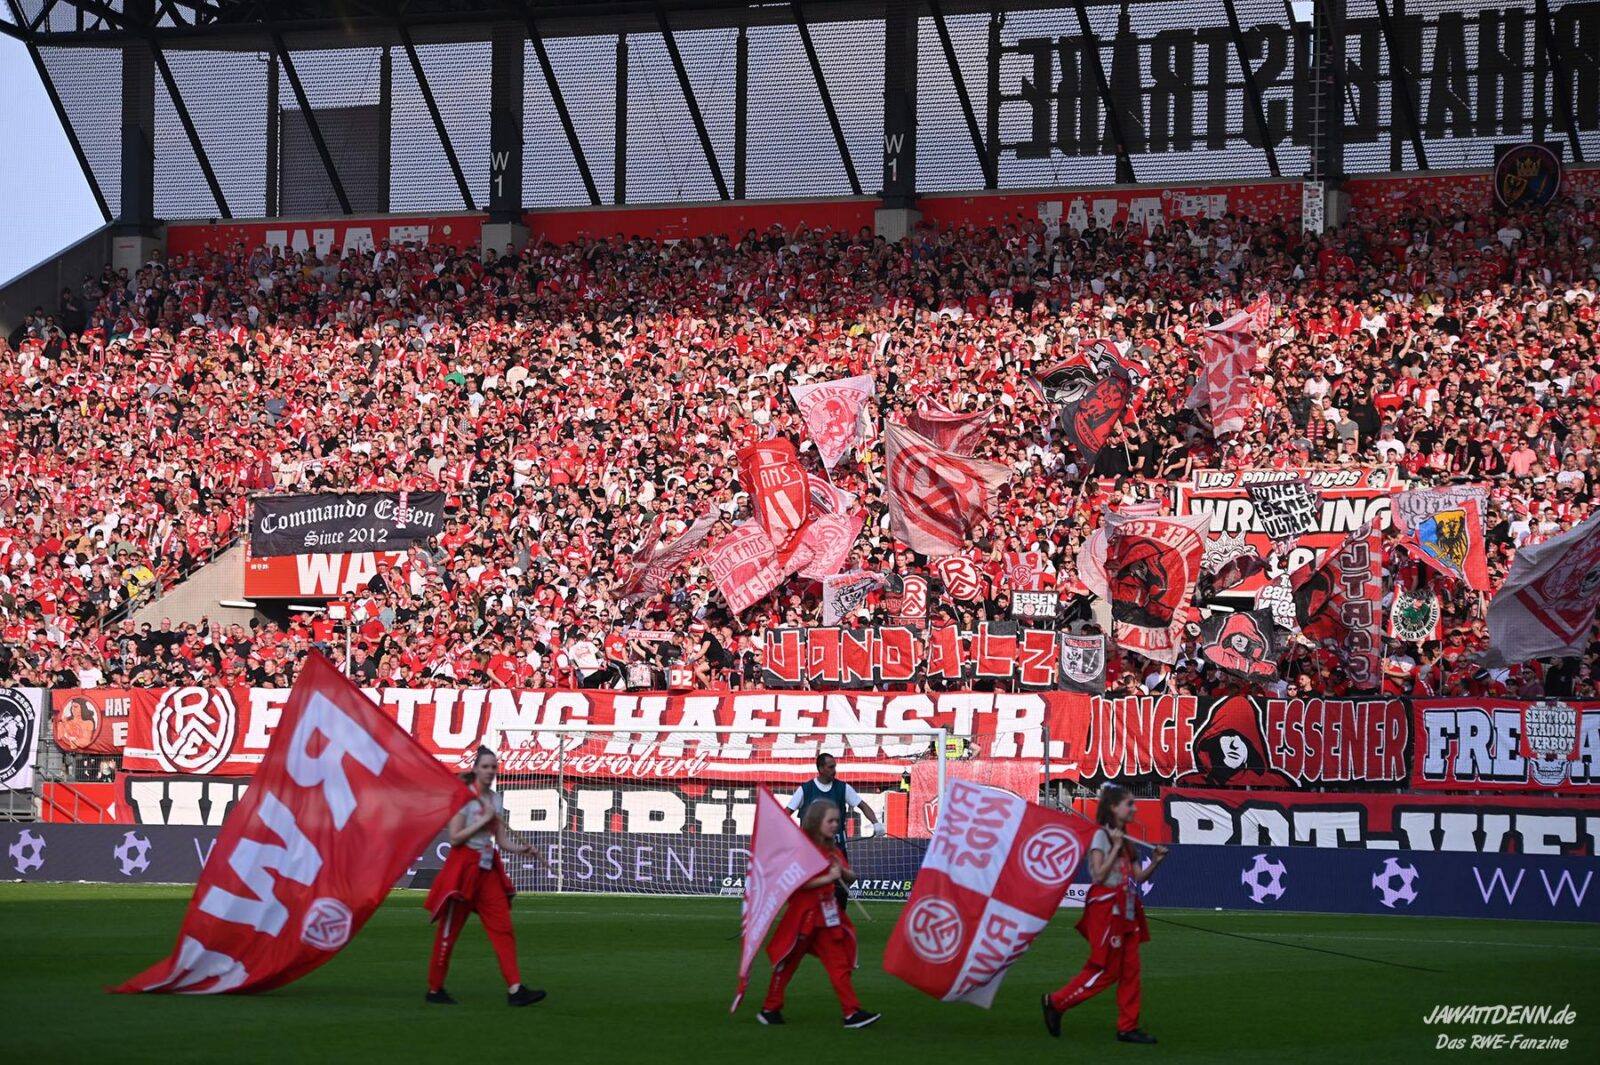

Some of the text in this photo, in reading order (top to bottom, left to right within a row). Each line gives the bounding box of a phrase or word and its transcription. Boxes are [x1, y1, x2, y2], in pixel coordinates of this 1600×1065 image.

[884, 133, 904, 154] W
[490, 152, 509, 170] W
[889, 159, 898, 181] 1
[494, 175, 503, 197] 1
[1200, 471, 1235, 488] LOS
[1305, 470, 1363, 489] OCOS
[260, 500, 368, 535] Commando
[304, 528, 388, 548] Since 2012
[1013, 593, 1057, 604] ESSEN
[244, 687, 591, 750] FTUNG
[1525, 710, 1577, 724] SEKTION
[1080, 695, 1407, 783] JUNGE ESSENER
[1526, 723, 1577, 737] STADION
[1528, 737, 1575, 750] VERBOT
